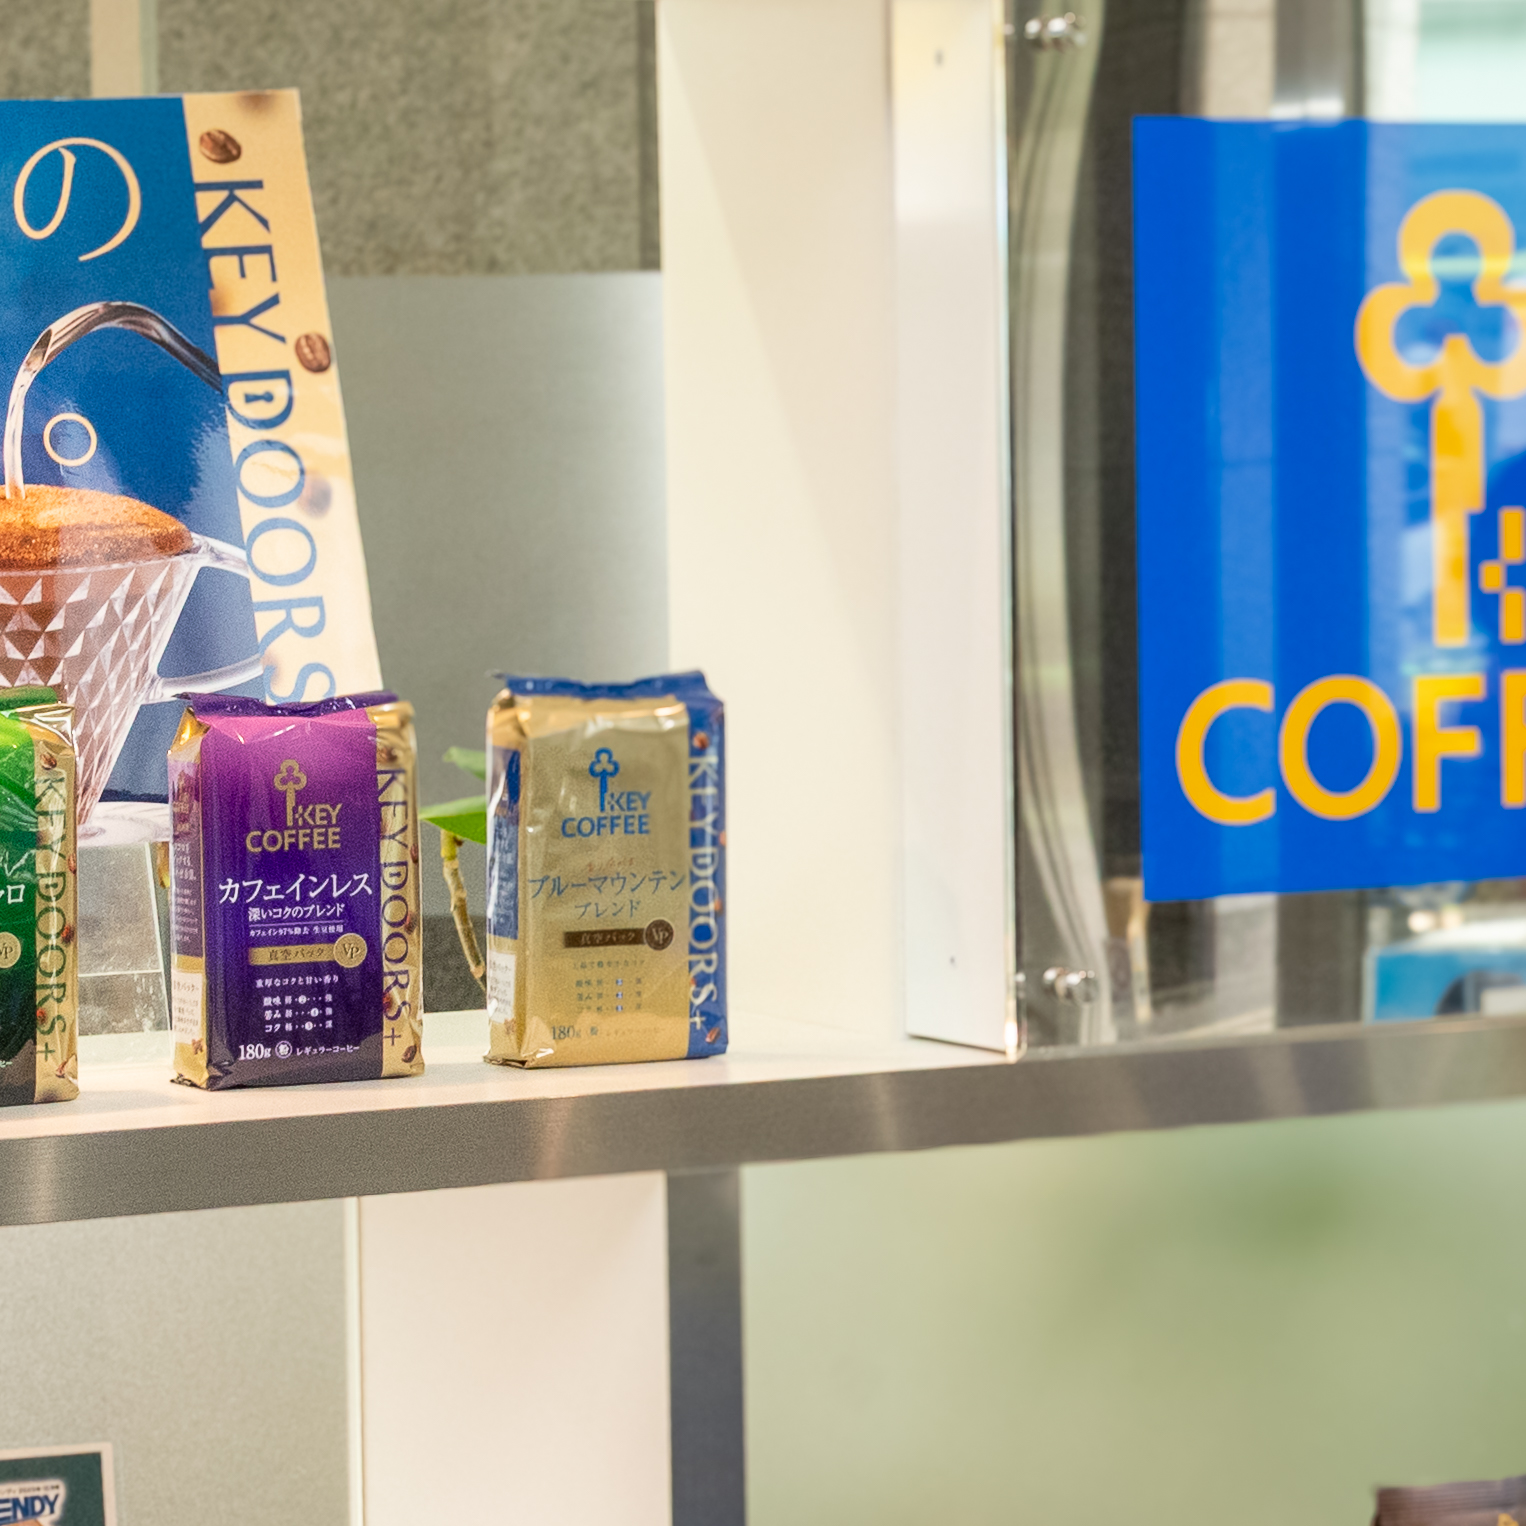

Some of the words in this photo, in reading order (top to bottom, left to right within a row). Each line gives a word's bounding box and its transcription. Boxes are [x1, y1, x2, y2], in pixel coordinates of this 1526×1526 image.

[13, 137, 141, 262] の
[193, 179, 288, 344] KEY
[377, 768, 409, 850] KEY
[607, 790, 652, 813] KEY
[295, 803, 343, 827] KEY
[561, 813, 650, 838] COFFEE
[245, 827, 342, 853] COFFEE
[0, 884, 26, 905] ロ
[218, 872, 373, 904] カフェインレス
[528, 870, 686, 899] ブルーマウンテン
[248, 903, 346, 922] 深いコクのブレンド
[574, 899, 642, 919] ブレンド
[381, 860, 412, 1046] DOORS+
[238, 1043, 272, 1061] 180g
